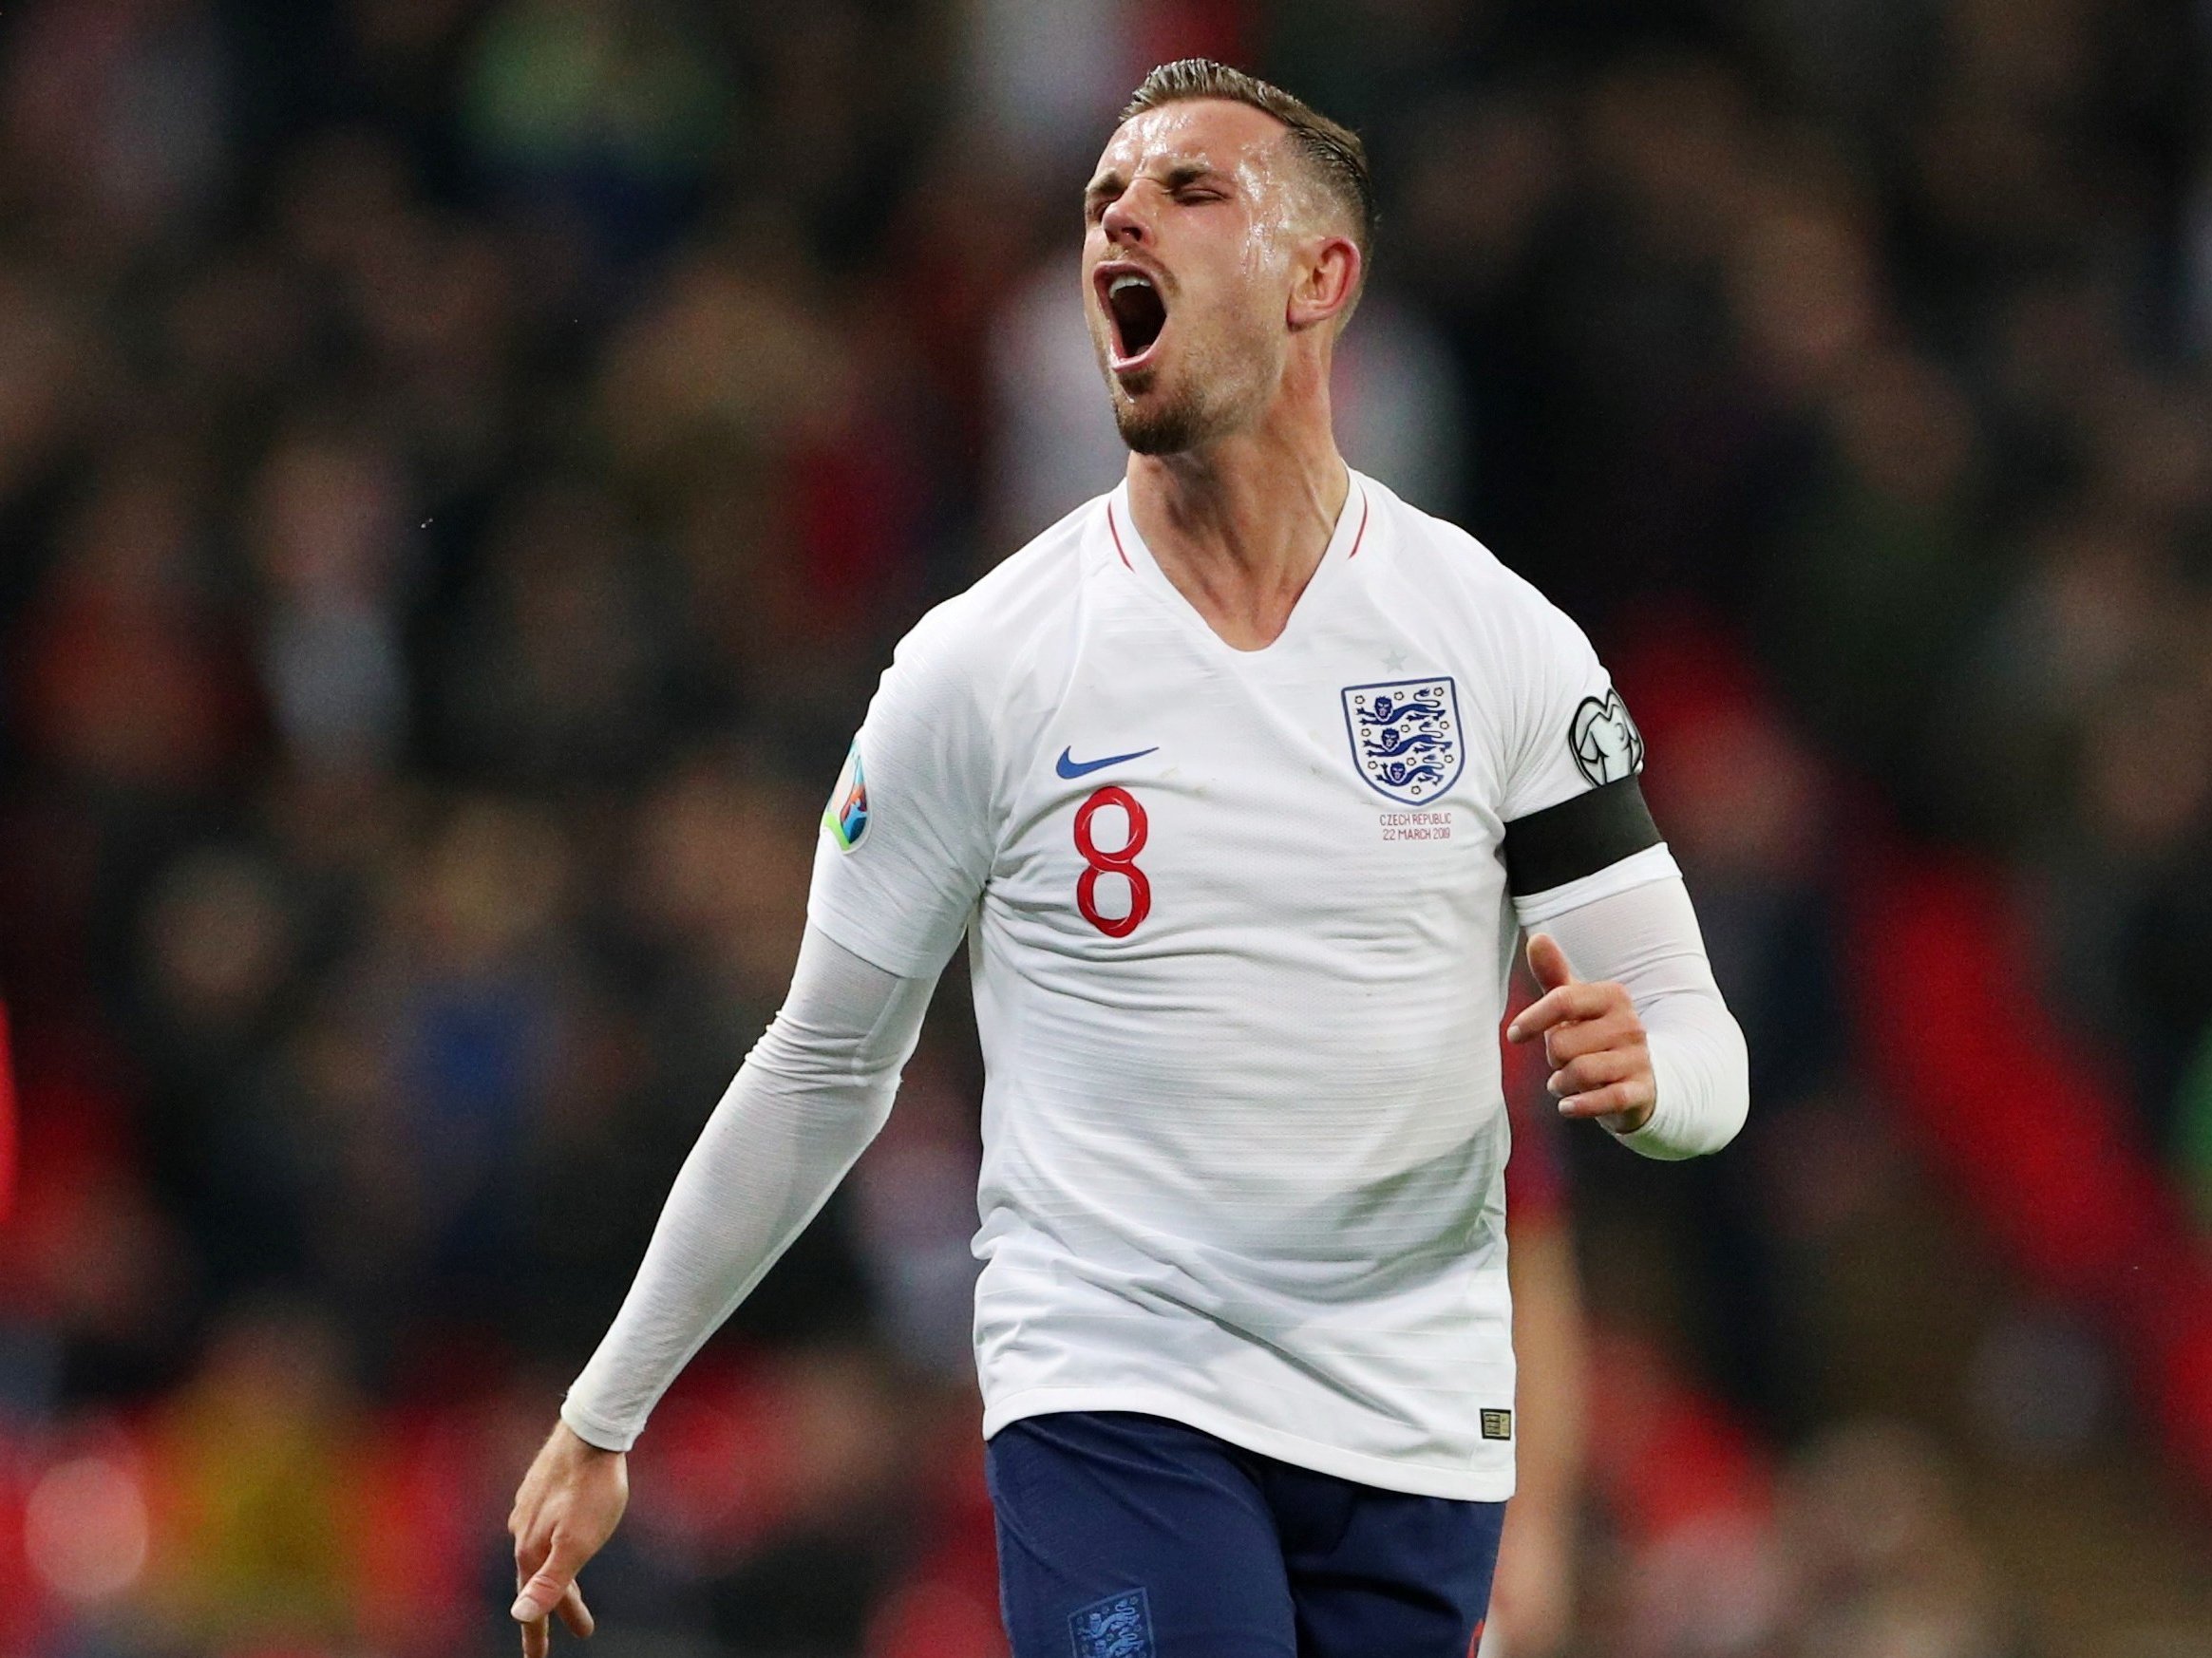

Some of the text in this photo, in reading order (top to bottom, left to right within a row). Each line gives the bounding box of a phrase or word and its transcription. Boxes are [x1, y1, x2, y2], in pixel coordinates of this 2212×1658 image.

[1379, 813, 1451, 826] CZECH REPUBLIC
[1383, 828, 1396, 840] 22
[1398, 828, 1431, 840] MARCH
[1074, 786, 1151, 938] 8
